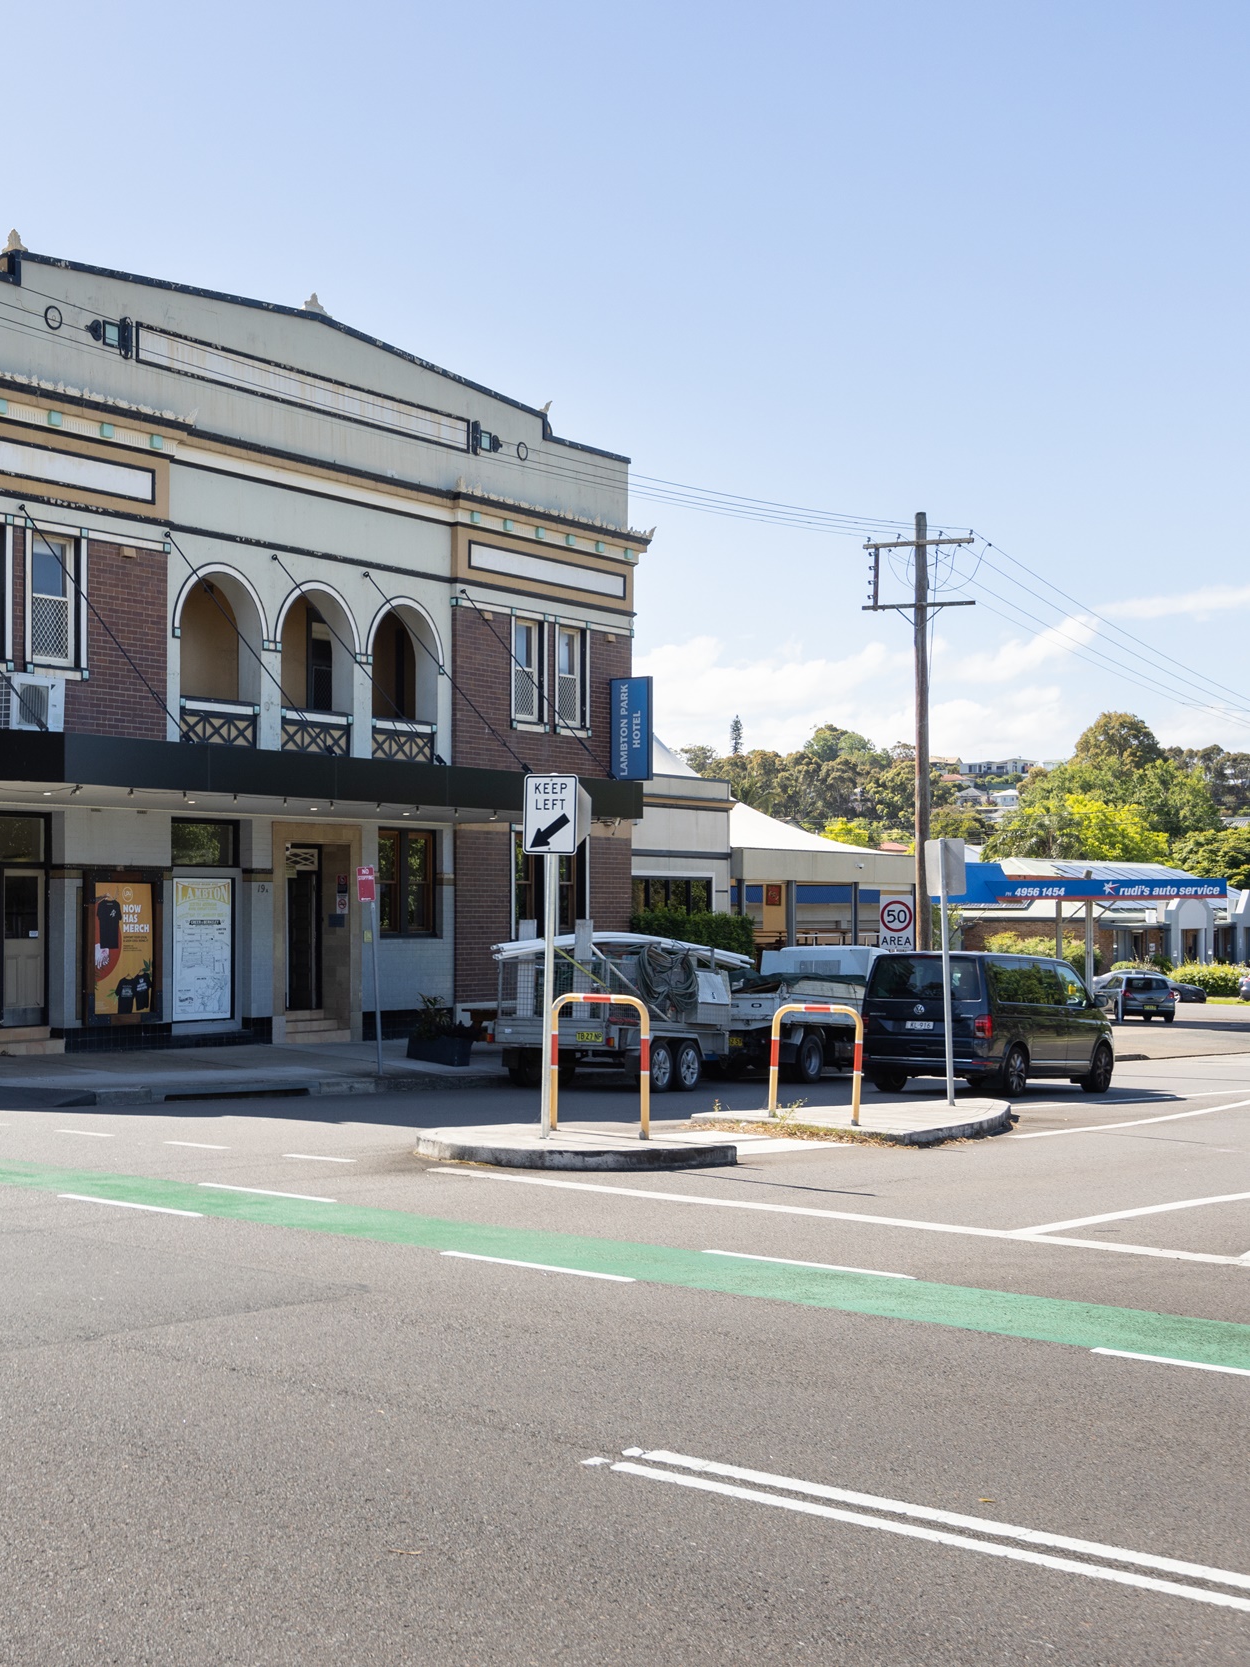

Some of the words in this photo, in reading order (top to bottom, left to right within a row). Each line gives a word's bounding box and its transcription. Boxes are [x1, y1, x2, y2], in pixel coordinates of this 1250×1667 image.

[620, 684, 628, 715] PARK
[632, 710, 641, 748] HOTEL
[620, 719, 628, 776] LAMBTON
[534, 782, 567, 794] KEEP
[535, 799, 566, 810] LEFT
[178, 884, 228, 905] LAMBTON
[1014, 888, 1039, 897] 4956
[1041, 887, 1065, 896] 1454
[1119, 885, 1150, 896] rudi's
[1152, 886, 1177, 895] auto
[1179, 885, 1220, 895] service
[122, 904, 141, 913] NOW
[123, 914, 138, 923] HAS
[886, 909, 907, 923] 50
[123, 924, 150, 932] MERCH
[881, 936, 912, 945] AREA
